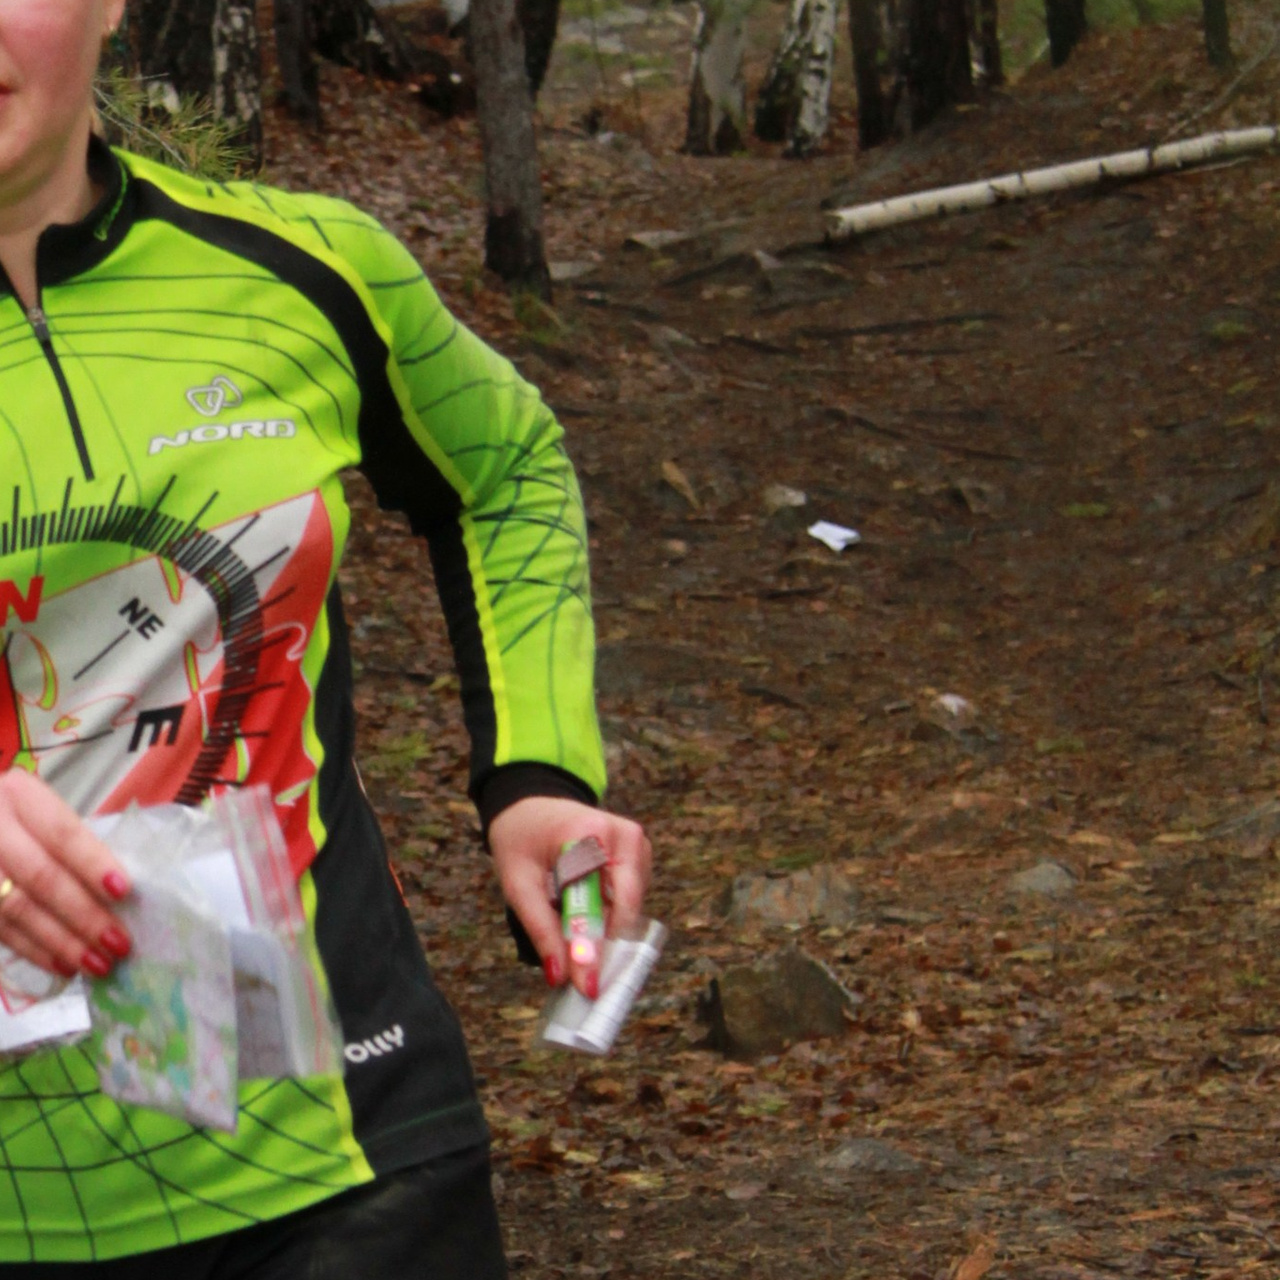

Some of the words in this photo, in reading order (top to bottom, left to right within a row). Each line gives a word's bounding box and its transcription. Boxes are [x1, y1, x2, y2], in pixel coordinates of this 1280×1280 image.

[148, 419, 296, 456] NORD
[118, 597, 165, 641] NE
[128, 705, 186, 753] E
